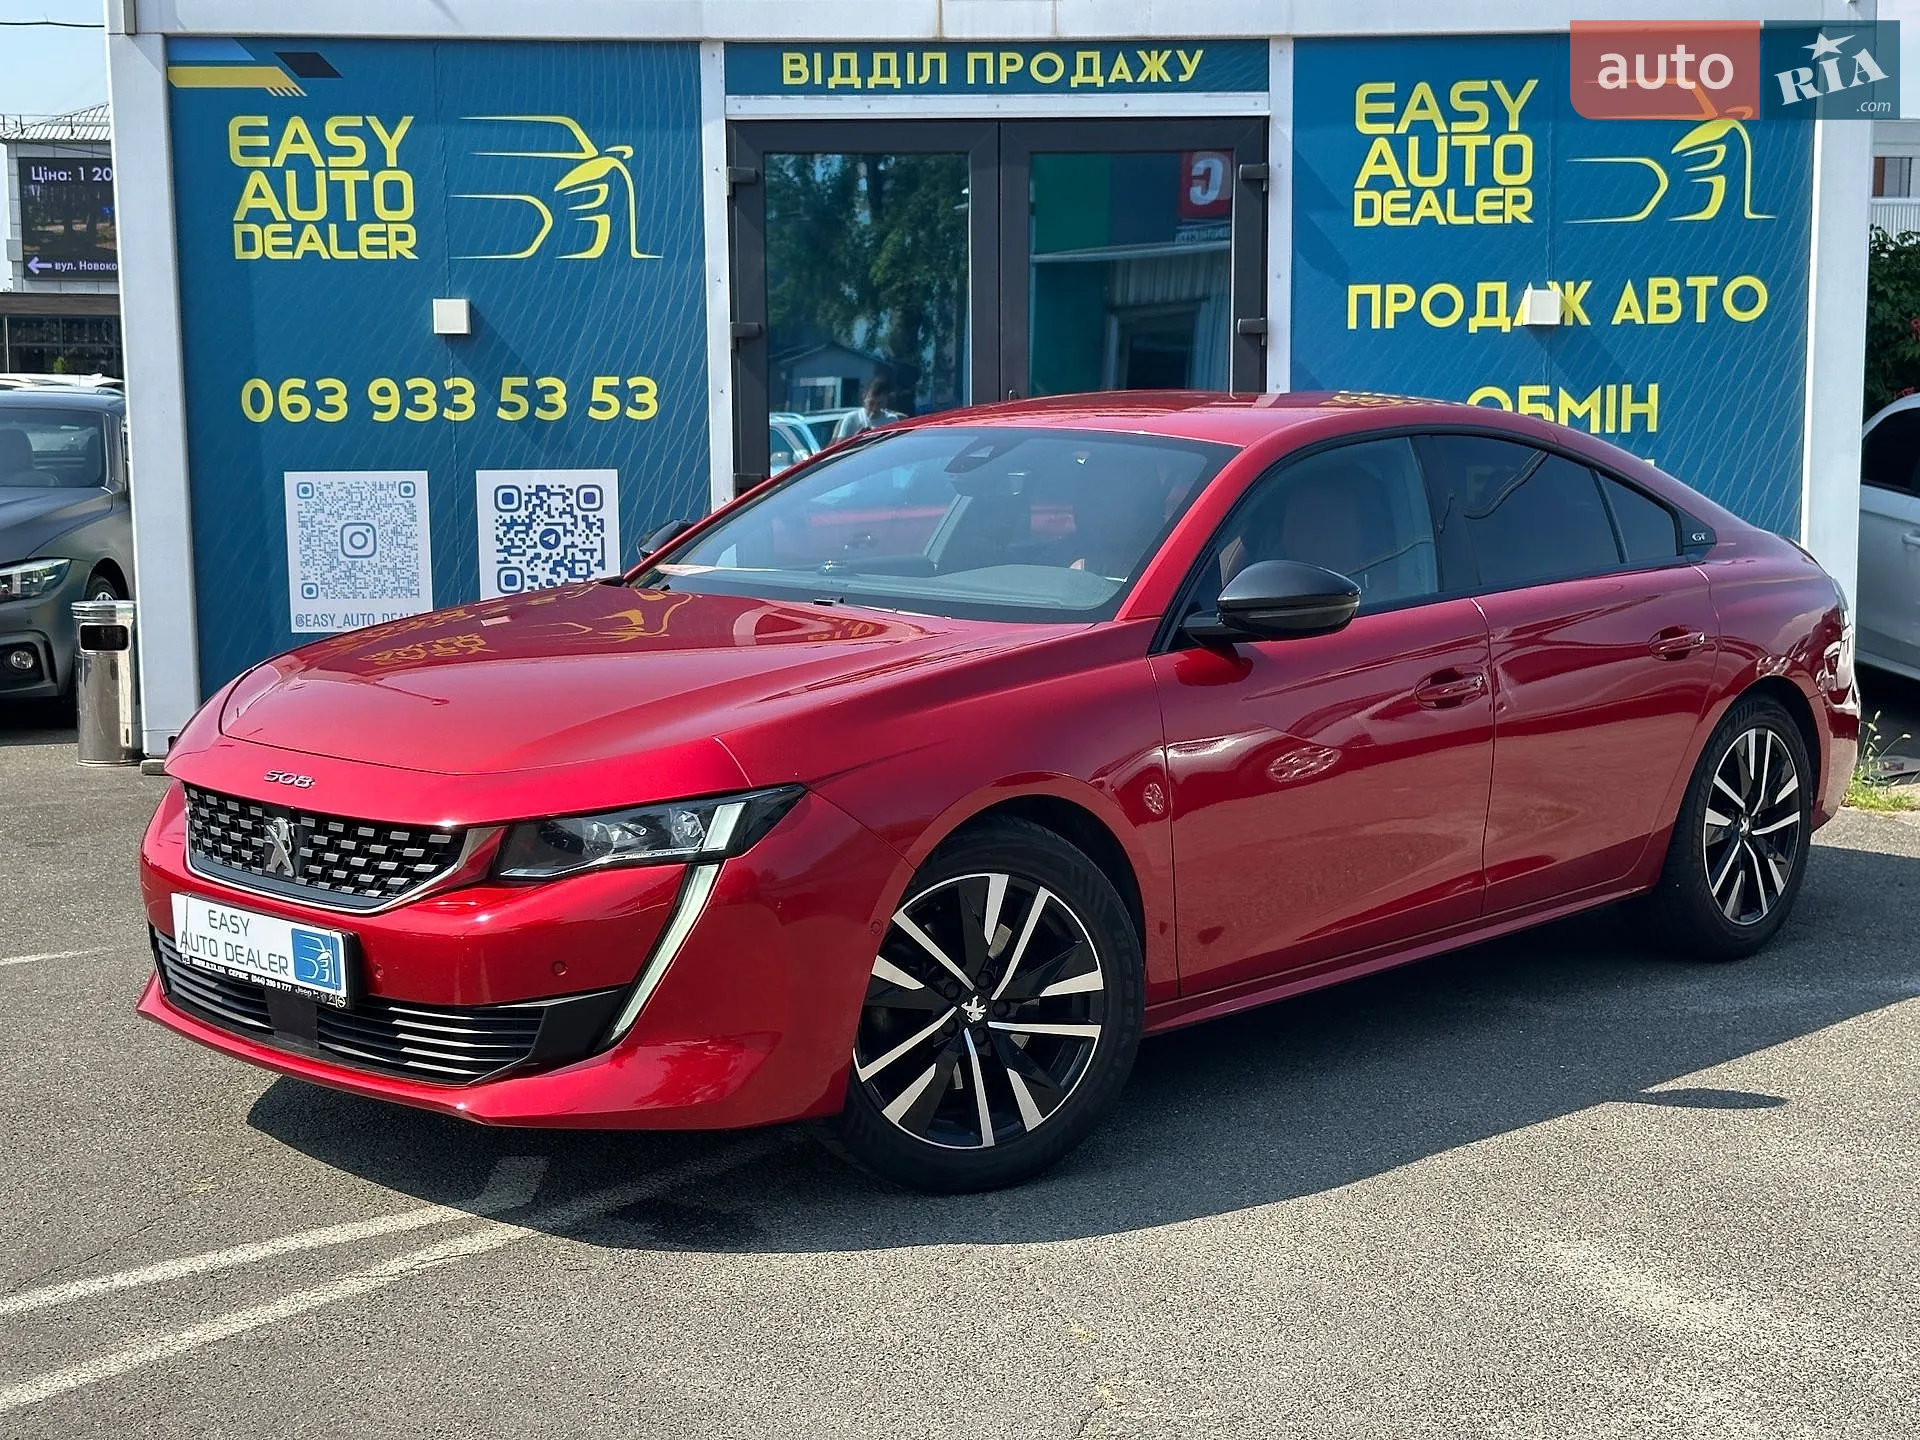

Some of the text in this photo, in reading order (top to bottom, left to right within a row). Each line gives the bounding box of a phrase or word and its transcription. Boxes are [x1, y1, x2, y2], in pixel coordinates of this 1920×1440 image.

[782, 50, 1204, 88] ВІДДІЛ ПРОДАЖУ
[1355, 79, 1538, 134] EASY
[229, 116, 413, 167] EASY
[1356, 134, 1533, 188] AUTO
[31, 166, 72, 183] Ціна:
[234, 170, 414, 221] AUTO
[1353, 188, 1532, 227] DEALER
[233, 223, 417, 260] DEALER
[1612, 275, 1768, 324] АВТО
[241, 376, 659, 422] 063 933 53 53
[263, 769, 315, 788] 508
[208, 909, 250, 936] EASY
[180, 930, 218, 958] AUTO
[224, 942, 289, 977] DEALER
